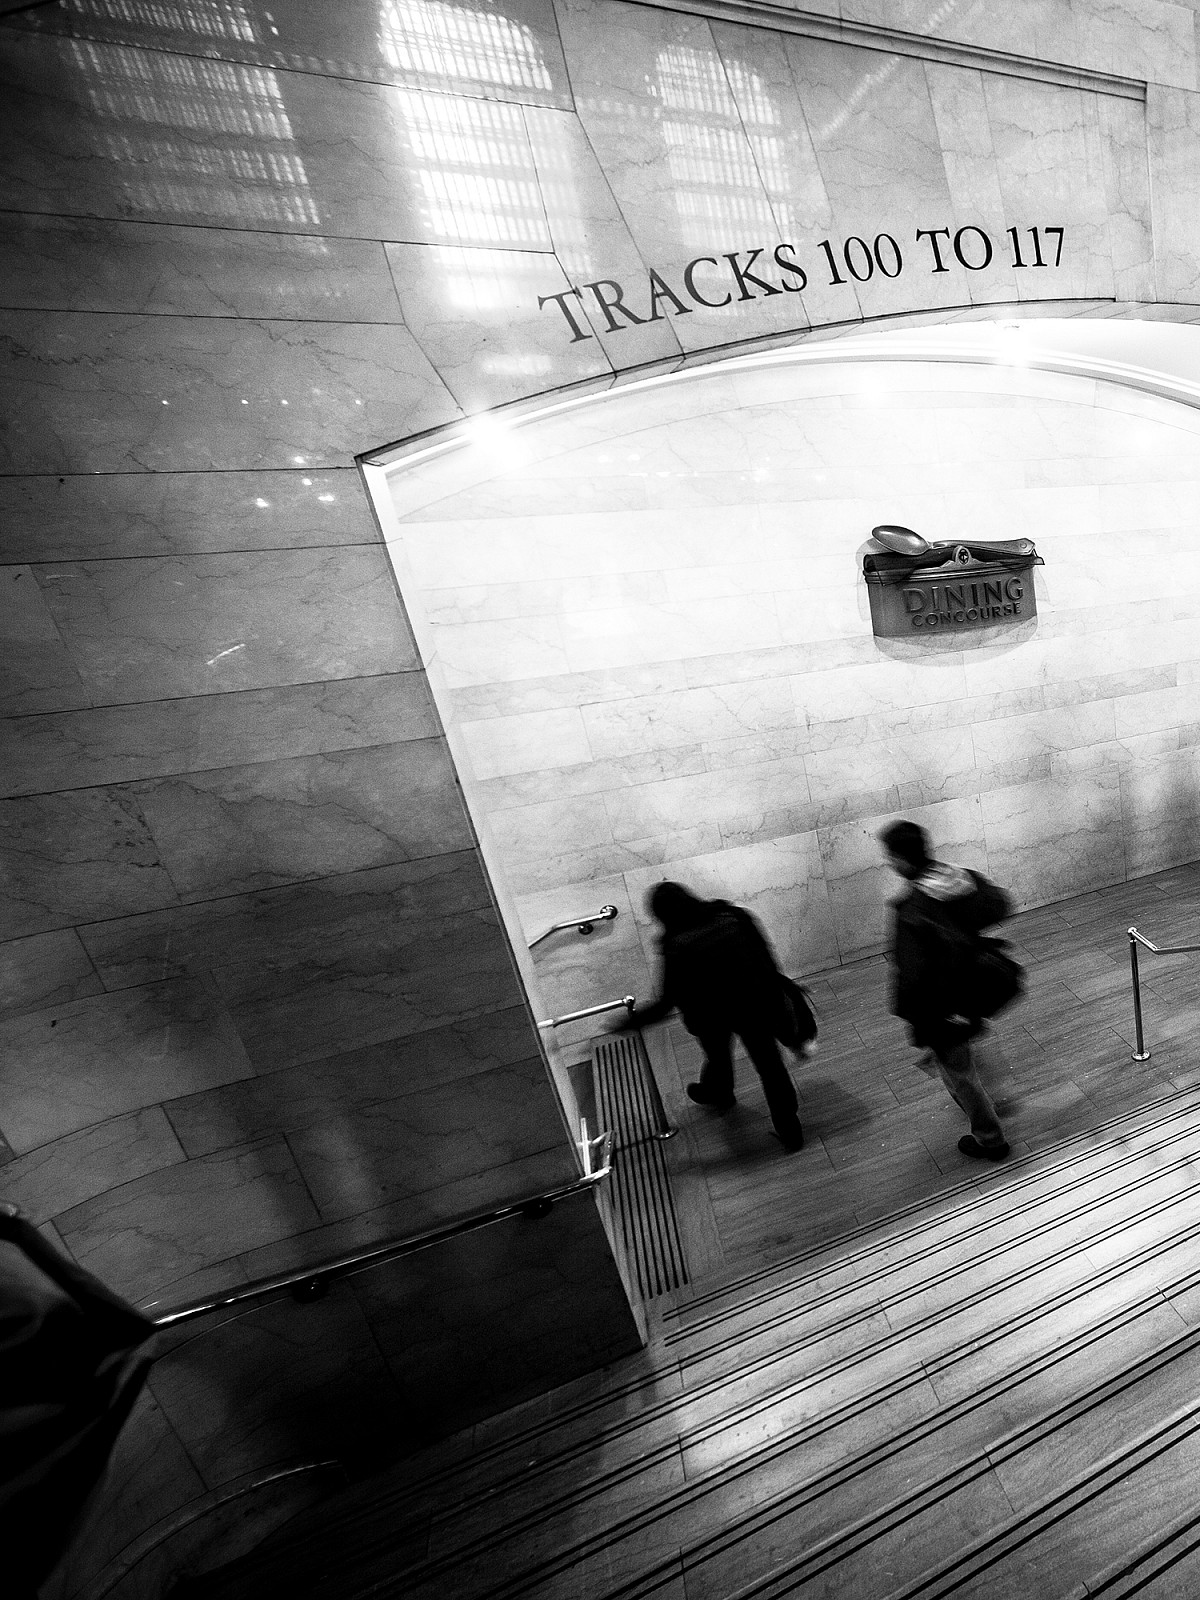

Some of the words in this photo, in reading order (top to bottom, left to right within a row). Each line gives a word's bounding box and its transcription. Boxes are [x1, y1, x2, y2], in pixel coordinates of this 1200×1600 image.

[537, 243, 808, 344] TRACKS
[817, 232, 904, 285] 100
[916, 225, 994, 273] TO
[1006, 226, 1066, 268] 117
[902, 576, 1024, 614] DINING
[911, 602, 1022, 627] CONCOURSE
